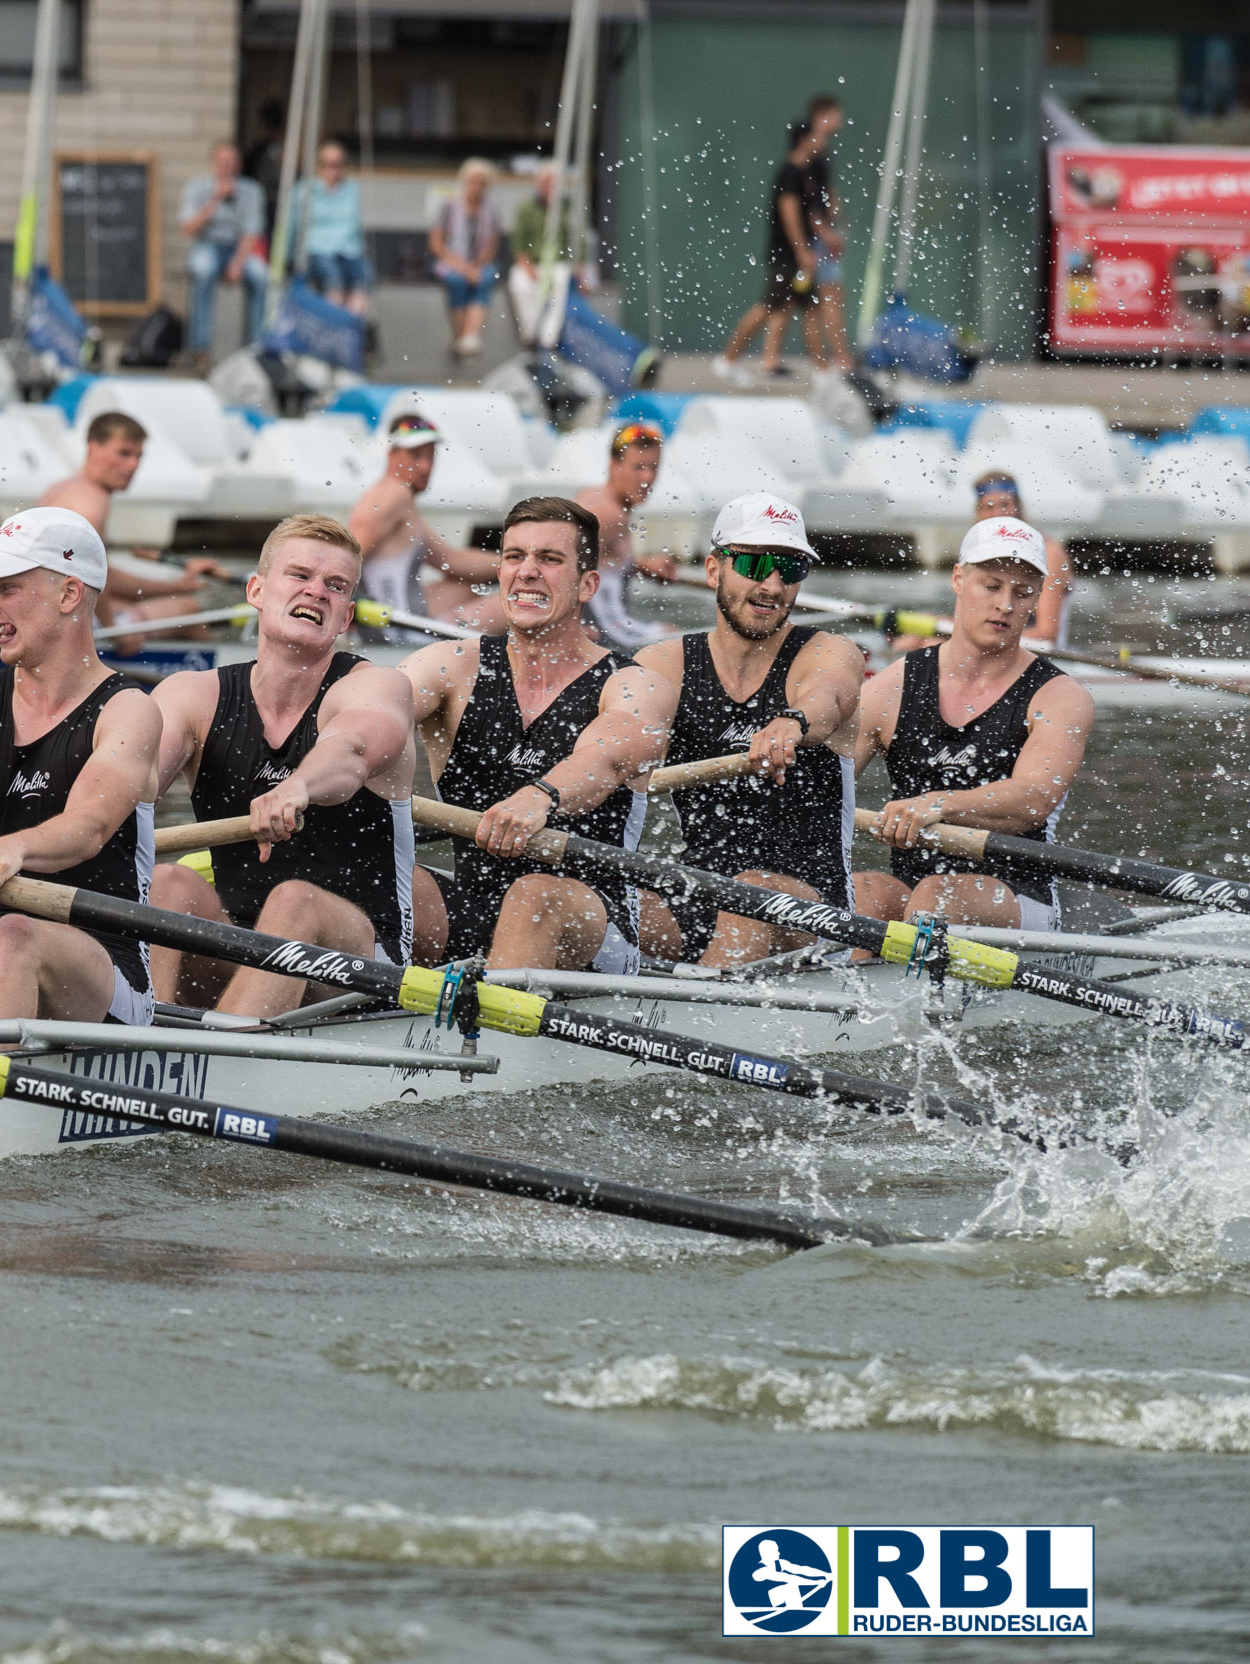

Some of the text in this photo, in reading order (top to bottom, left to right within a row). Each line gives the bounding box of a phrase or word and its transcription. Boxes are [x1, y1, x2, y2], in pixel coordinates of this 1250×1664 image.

[1021, 972, 1072, 998] STARK.
[548, 1018, 603, 1044] STARK.
[607, 1032, 684, 1062] SCHNELL.
[687, 1051, 725, 1072] GUT.
[738, 1060, 781, 1083] RBL
[15, 1077, 76, 1105] STARK.
[79, 1089, 164, 1121] SCHNELL.
[167, 1107, 209, 1129] GUT.
[223, 1114, 270, 1138] RBL
